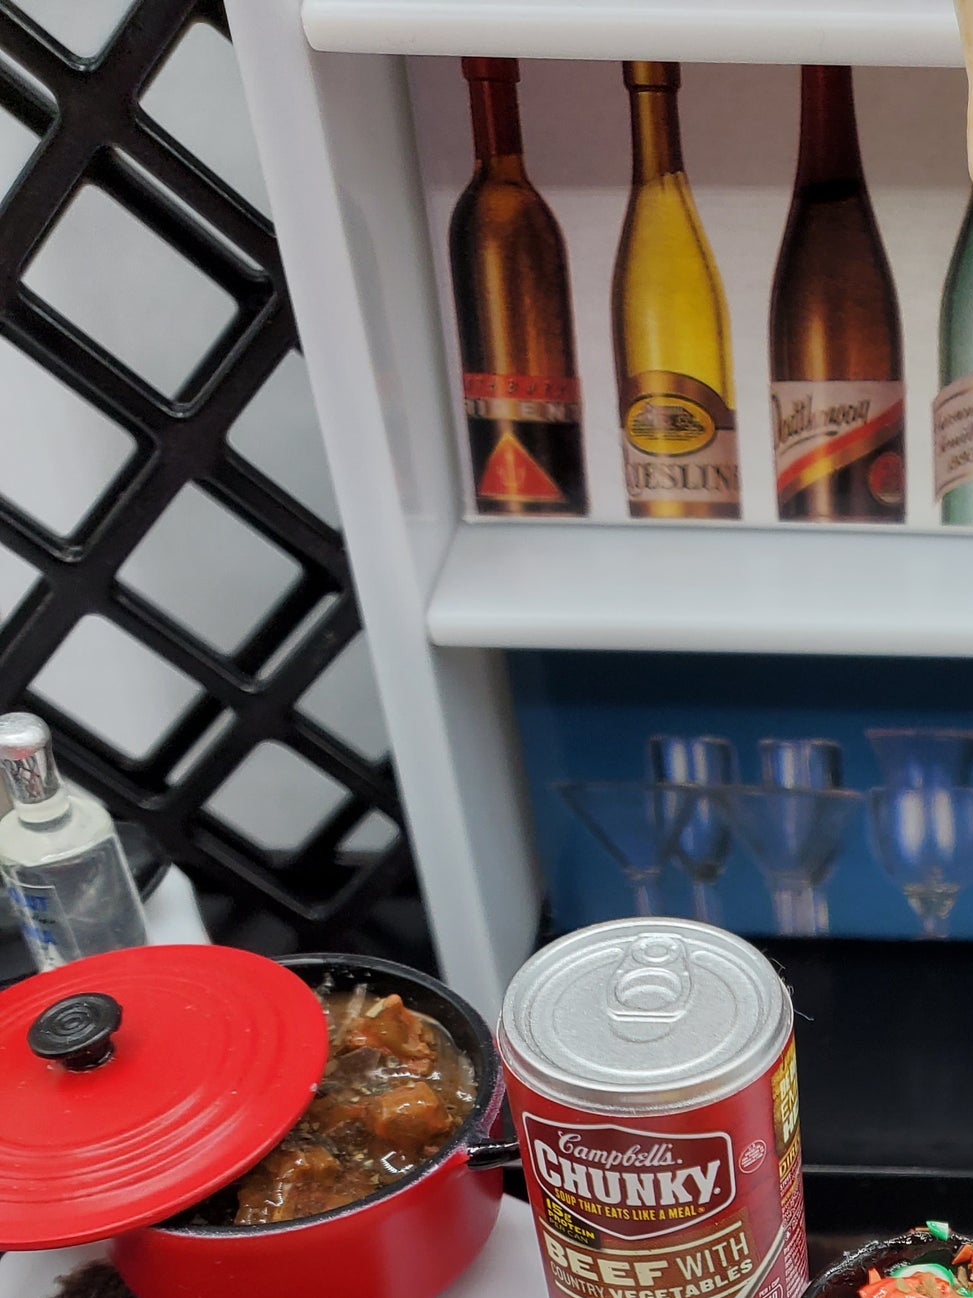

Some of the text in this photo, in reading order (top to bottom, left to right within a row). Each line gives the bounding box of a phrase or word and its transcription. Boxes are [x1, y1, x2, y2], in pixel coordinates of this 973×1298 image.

[558, 1131, 676, 1169] Campbell's
[534, 1139, 720, 1207] CHUNKY
[554, 1188, 697, 1221] SOUP THAT EATS LIKE A MEAL
[547, 1210, 596, 1240] PROTEIN
[543, 1230, 669, 1287] BEEF
[676, 1232, 750, 1281] WITH
